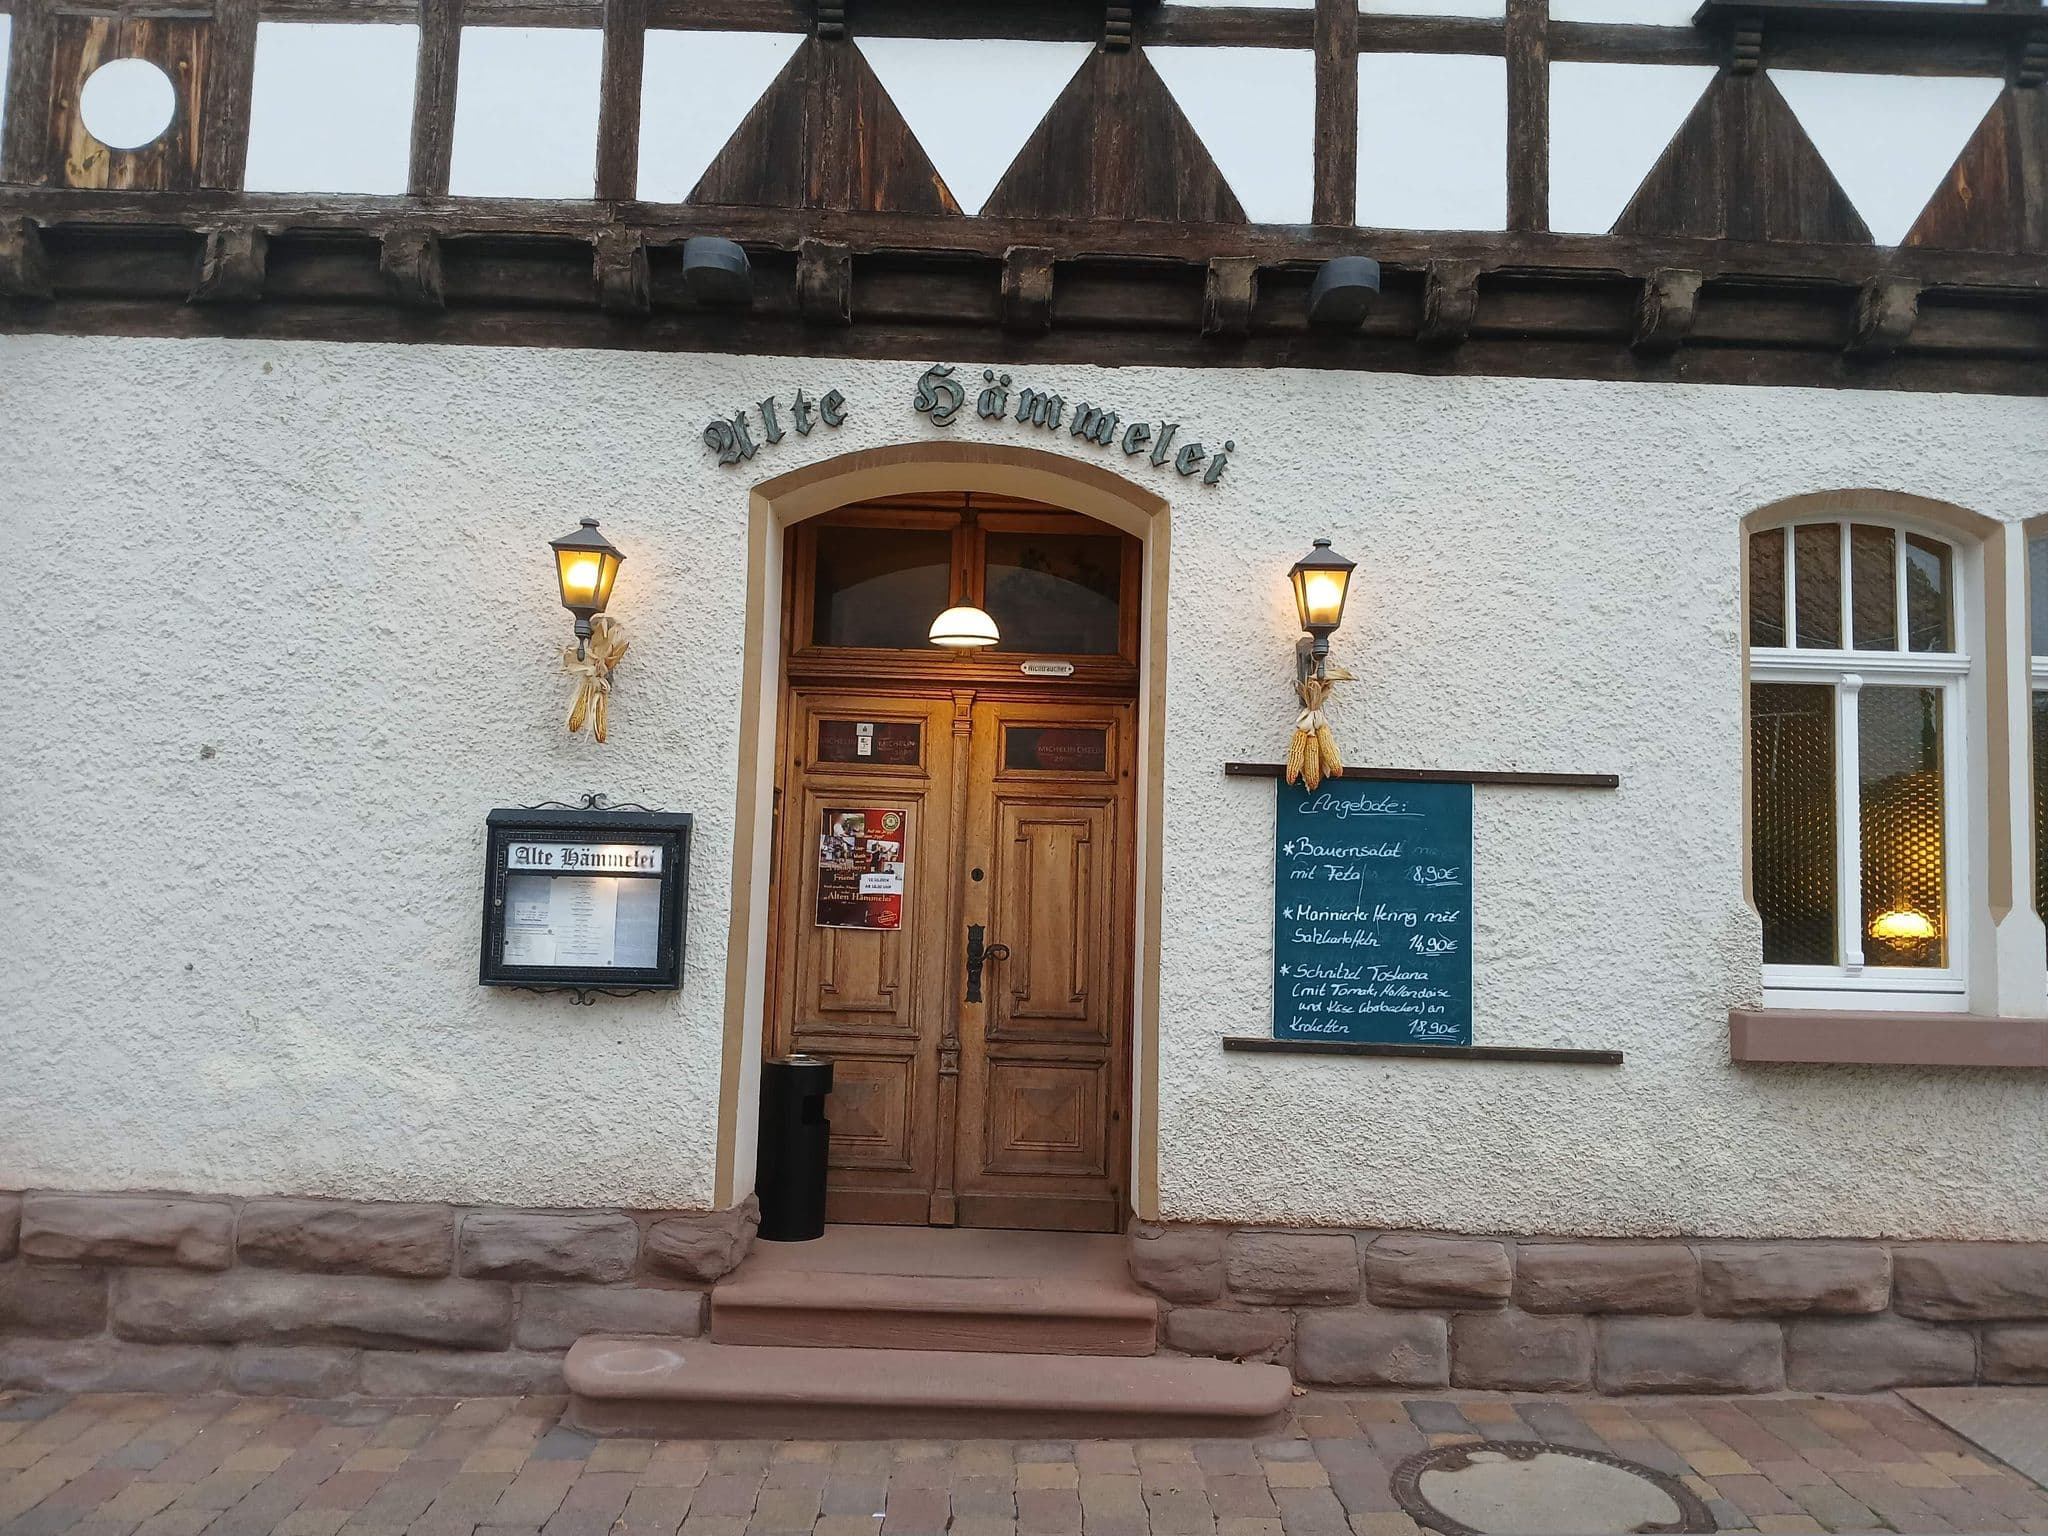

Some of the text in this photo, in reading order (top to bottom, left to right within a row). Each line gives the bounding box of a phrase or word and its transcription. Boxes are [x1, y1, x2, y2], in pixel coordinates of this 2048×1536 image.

[704, 363, 1235, 486] Alte Hämmelei
[1299, 793, 1407, 819] Angebote:
[515, 847, 656, 869] Alte Hämmelei
[1295, 837, 1402, 860] Bauernsalat
[1290, 864, 1459, 884] mit Feta 8,90€
[1373, 903, 1417, 928] Hering
[1424, 910, 1460, 923] mit
[1367, 965, 1429, 981] Toskana
[1292, 983, 1326, 997] (mit
[1298, 1000, 1322, 1012] und
[1428, 1003, 1445, 1013] an
